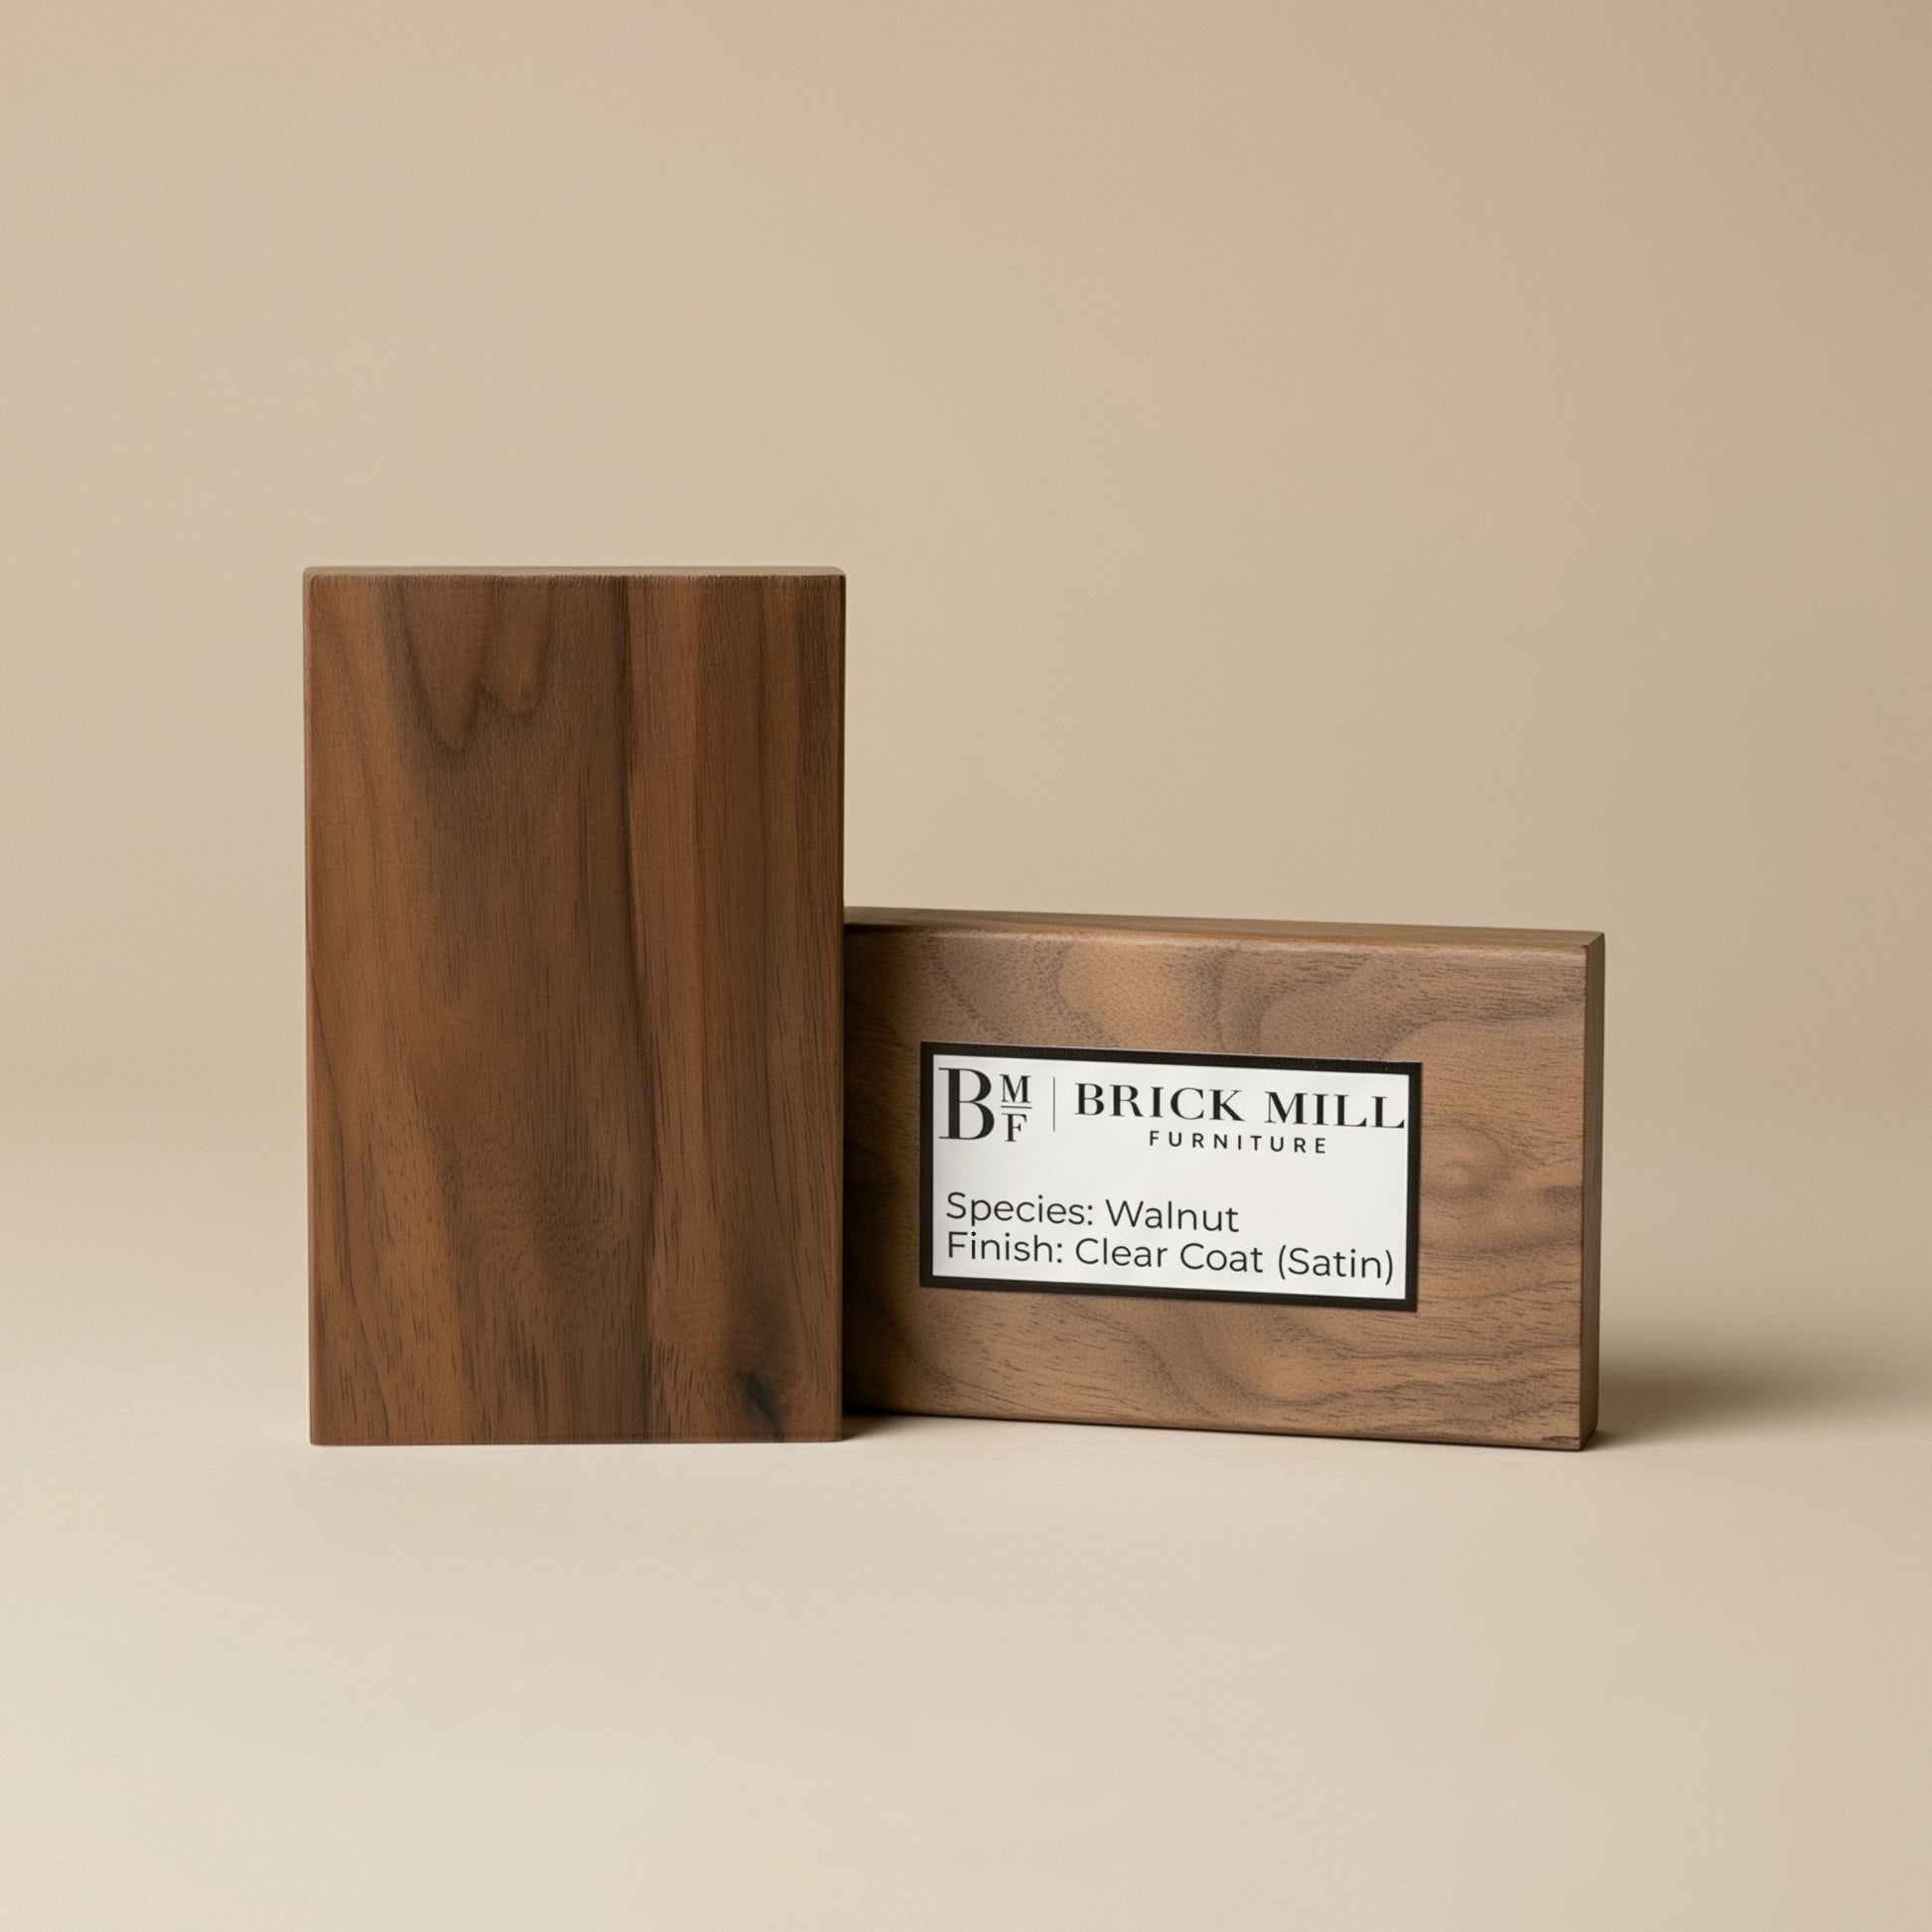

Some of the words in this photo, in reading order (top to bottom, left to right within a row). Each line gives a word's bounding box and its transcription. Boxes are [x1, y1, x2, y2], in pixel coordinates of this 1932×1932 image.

[1074, 1082, 1246, 1122] BRICK
[1264, 1090, 1406, 1130] MILL
[1149, 1129, 1327, 1155] FURNITURE
[945, 1191, 1094, 1227] Species:
[1105, 1198, 1240, 1233] Walnut
[948, 1230, 1063, 1264] Finish:
[1074, 1237, 1169, 1268] Clear
[1178, 1242, 1264, 1274] Coat
[1278, 1244, 1394, 1287] (Satin)
